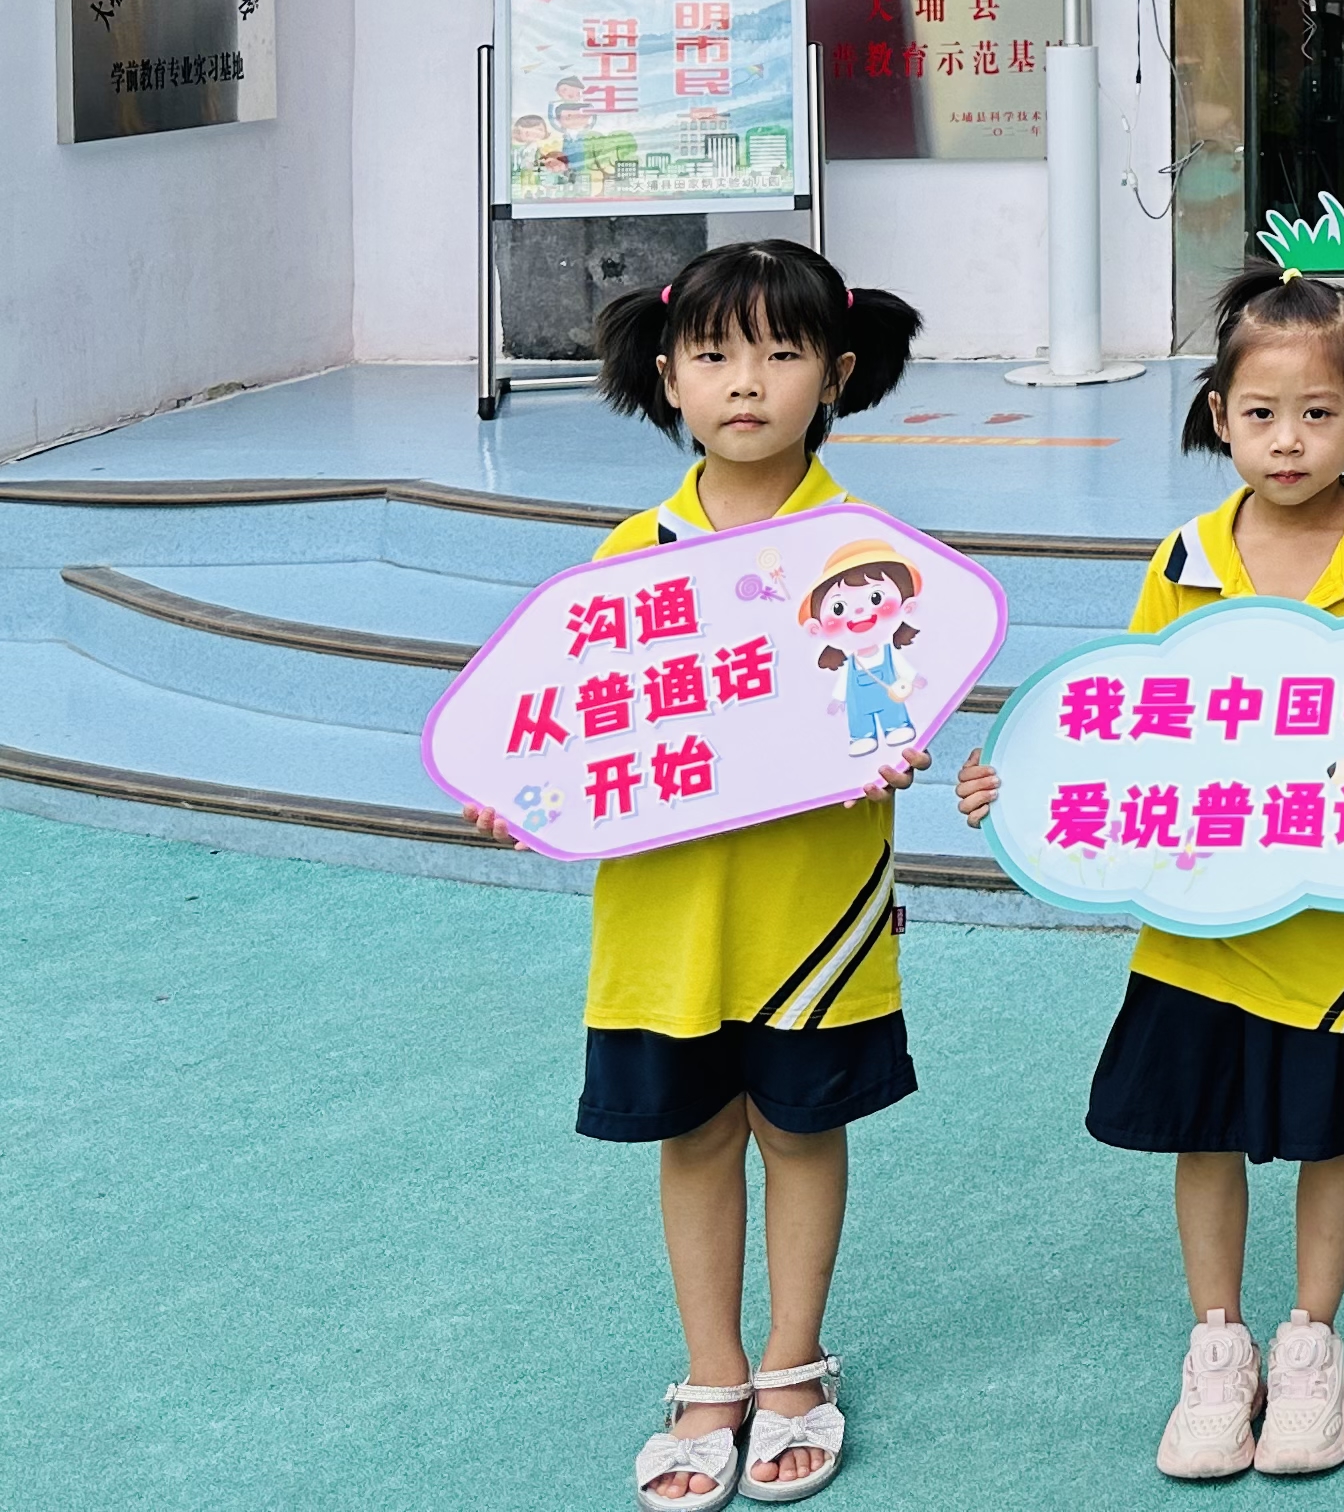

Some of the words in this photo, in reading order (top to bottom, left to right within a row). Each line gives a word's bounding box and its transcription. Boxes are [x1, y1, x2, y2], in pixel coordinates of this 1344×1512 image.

[110, 49, 246, 95] 学前教育专业实习基地
[832, 39, 1064, 79] 普教育示范基
[950, 110, 1048, 123] 大埔县科学技术
[565, 575, 701, 659] 沟通
[505, 633, 778, 756] 从普通话
[584, 732, 718, 823] 开始
